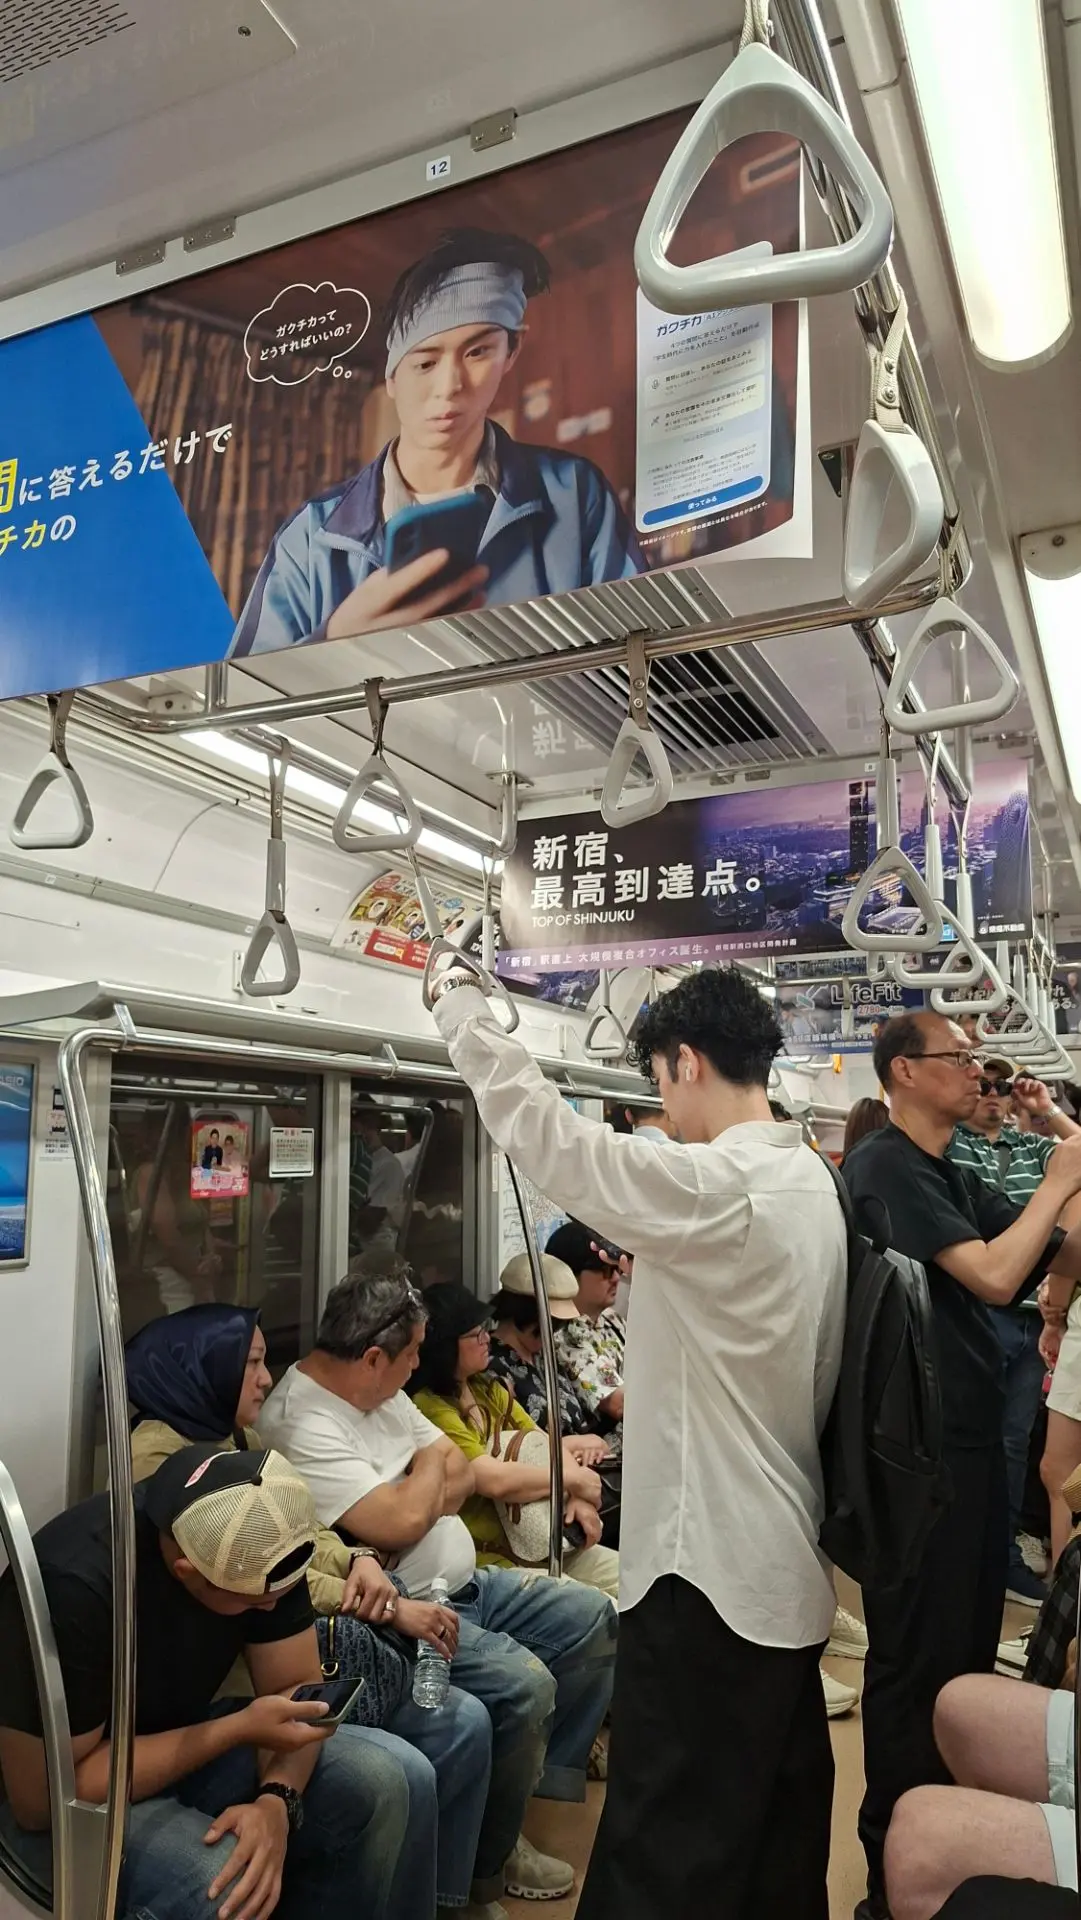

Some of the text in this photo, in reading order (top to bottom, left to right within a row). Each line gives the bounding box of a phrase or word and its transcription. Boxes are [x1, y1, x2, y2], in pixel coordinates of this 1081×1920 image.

[431, 161, 447, 175] 12
[276, 309, 337, 338] ガクチカって
[657, 314, 702, 337] ガクチカ
[260, 323, 352, 360] どうすればいいの？
[532, 831, 624, 871] 新宿、
[530, 858, 762, 911] 最高到達点。
[532, 909, 635, 928] TOP OF SHINJUKU
[831, 981, 902, 1005] LfeFit
